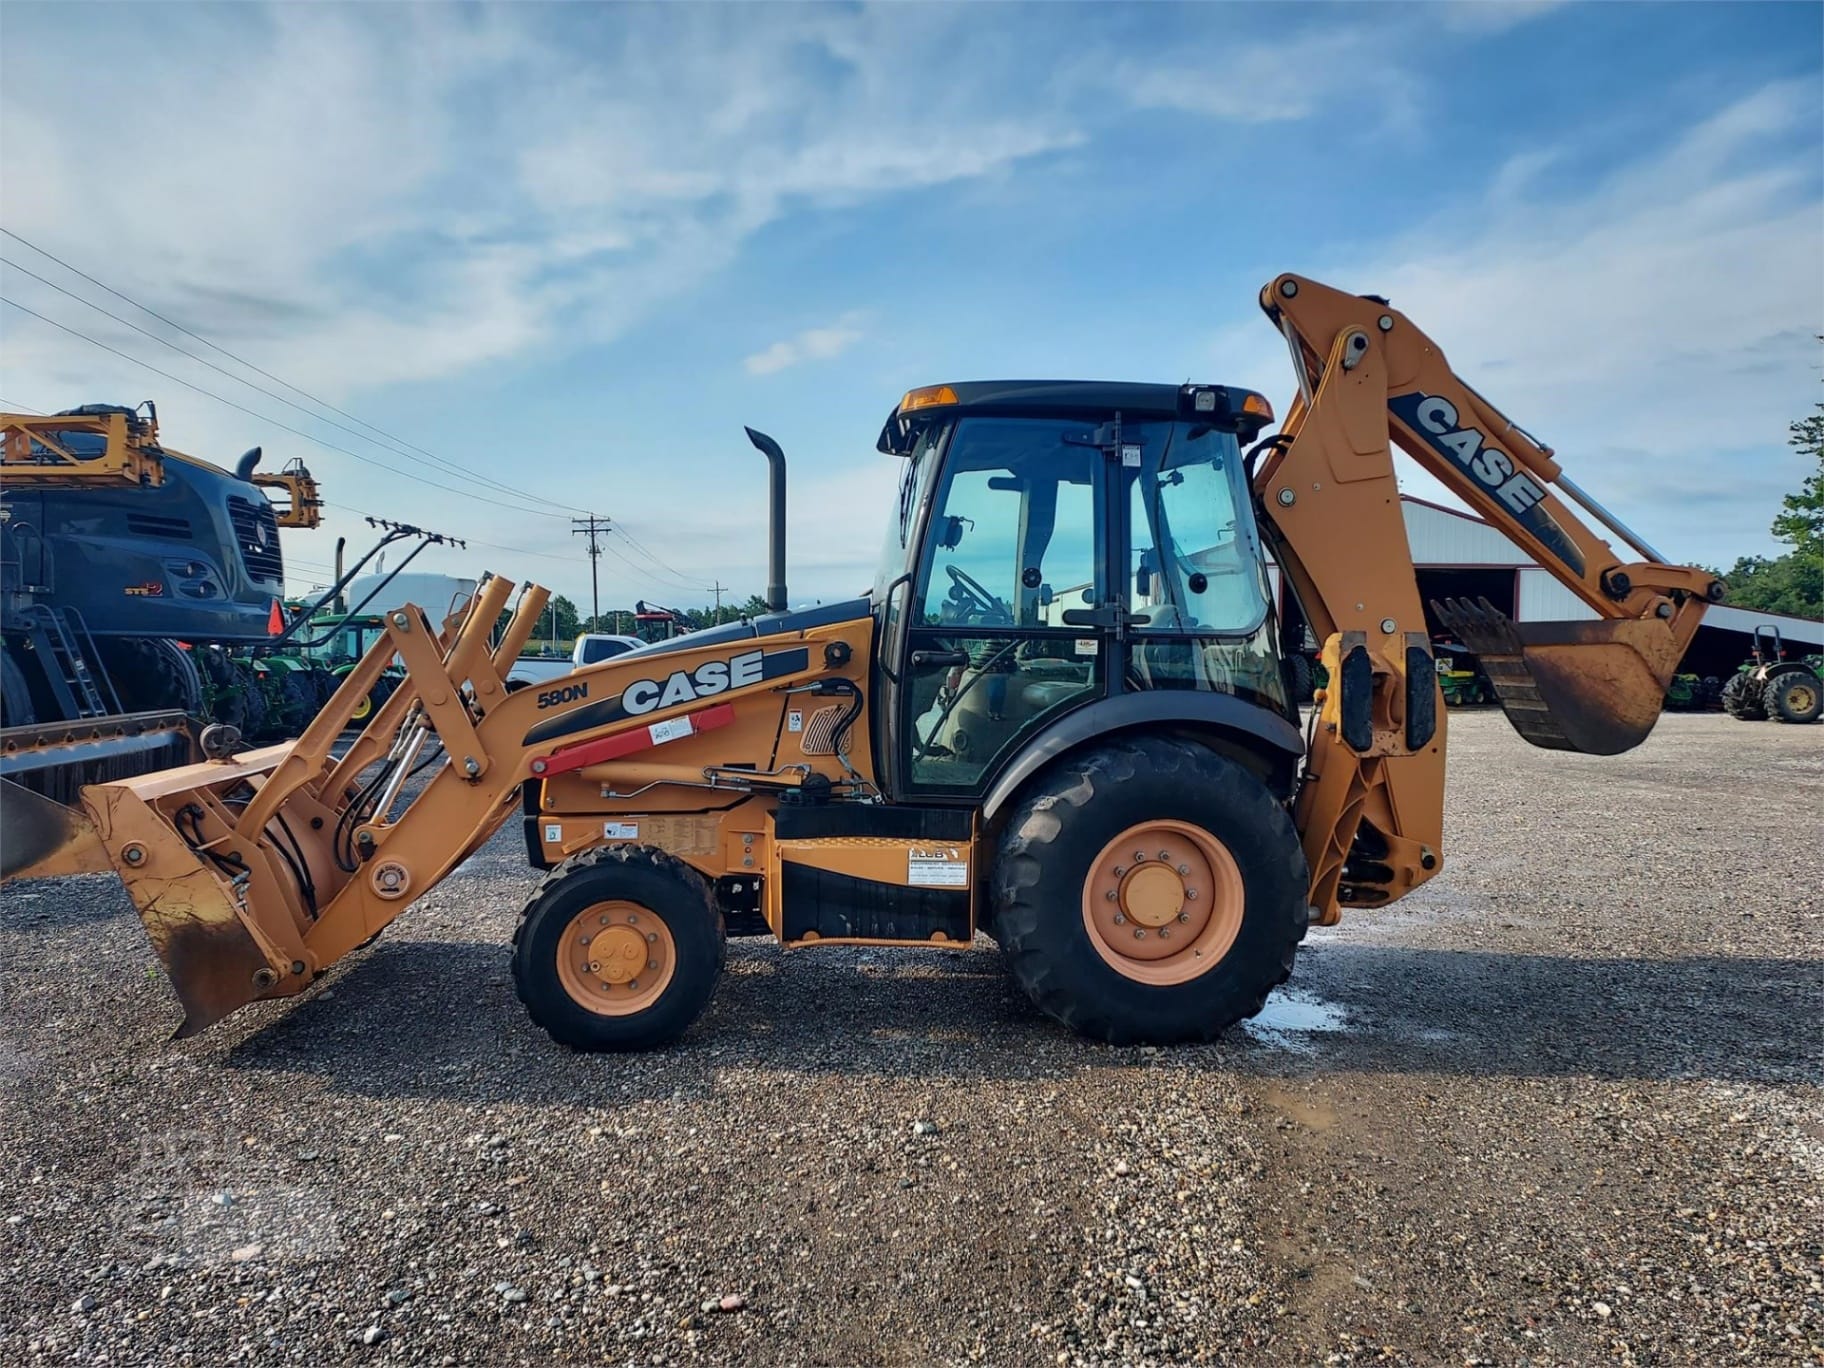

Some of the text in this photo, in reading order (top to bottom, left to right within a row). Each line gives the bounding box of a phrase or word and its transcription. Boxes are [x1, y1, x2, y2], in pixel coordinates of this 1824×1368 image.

[1416, 396, 1547, 515] CASE
[537, 682, 588, 709] 580N
[622, 650, 764, 715] CASE
